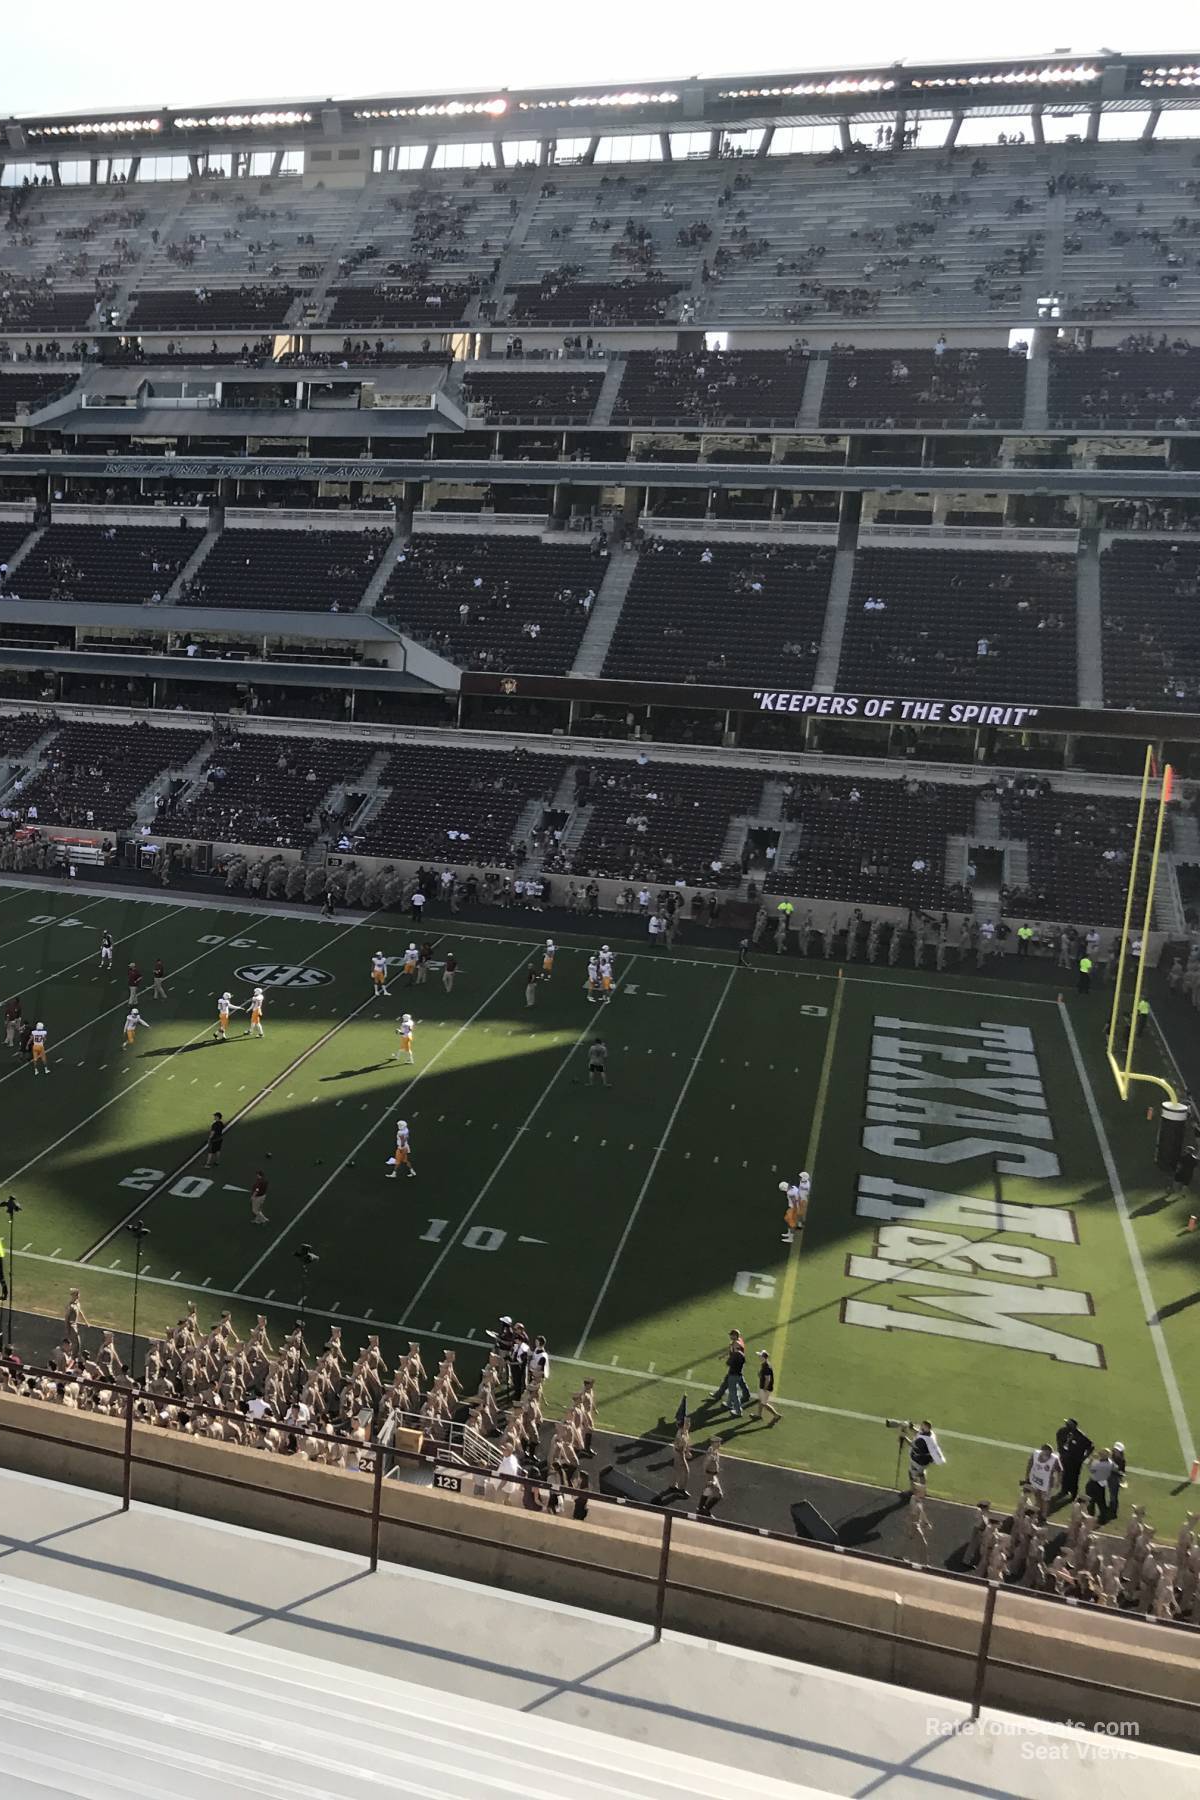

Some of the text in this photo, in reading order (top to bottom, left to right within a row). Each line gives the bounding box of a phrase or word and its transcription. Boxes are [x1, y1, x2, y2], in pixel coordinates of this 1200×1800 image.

[753, 692, 1039, 726] "KEEPERS OF THE SPIRIT"
[118, 1167, 215, 1198] 20
[839, 1015, 1108, 1370] TEXAS A&M
[418, 1218, 508, 1251] 10
[732, 1270, 777, 1300] G
[359, 1459, 379, 1472] 24
[437, 1476, 458, 1490] 123
